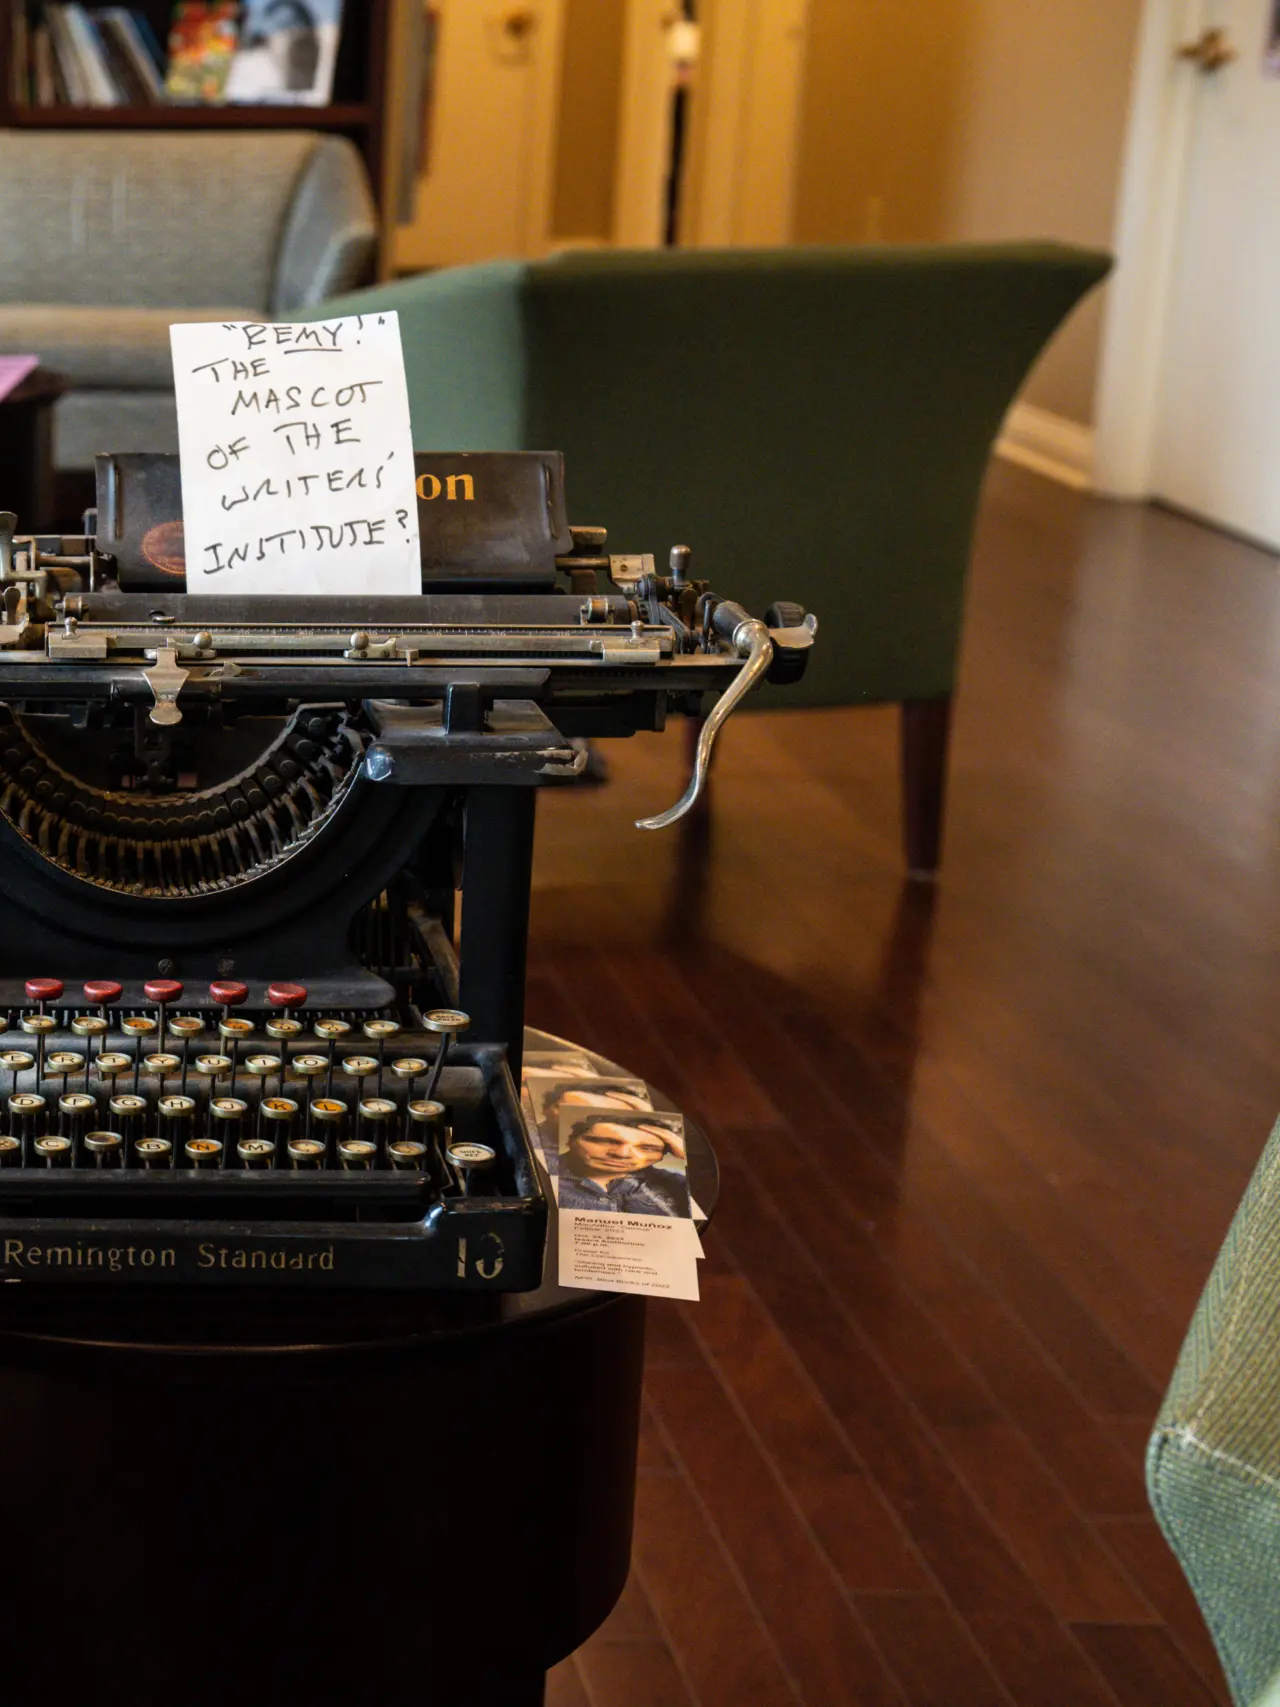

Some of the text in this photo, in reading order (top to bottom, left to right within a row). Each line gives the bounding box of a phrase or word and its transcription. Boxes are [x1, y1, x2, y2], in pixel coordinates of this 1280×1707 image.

[192, 357, 271, 384] THE
[230, 380, 383, 416] MASCOT
[206, 418, 361, 471] OF THE
[415, 472, 475, 501] on
[203, 509, 412, 576] INSTITUTE?
[20, 1098, 34, 1106] D
[121, 1099, 137, 1107] G
[274, 1103, 288, 1111] K
[574, 1217, 673, 1230] Manuel Muñoz
[4, 1239, 176, 1273] Remington
[197, 1242, 335, 1271] Standard
